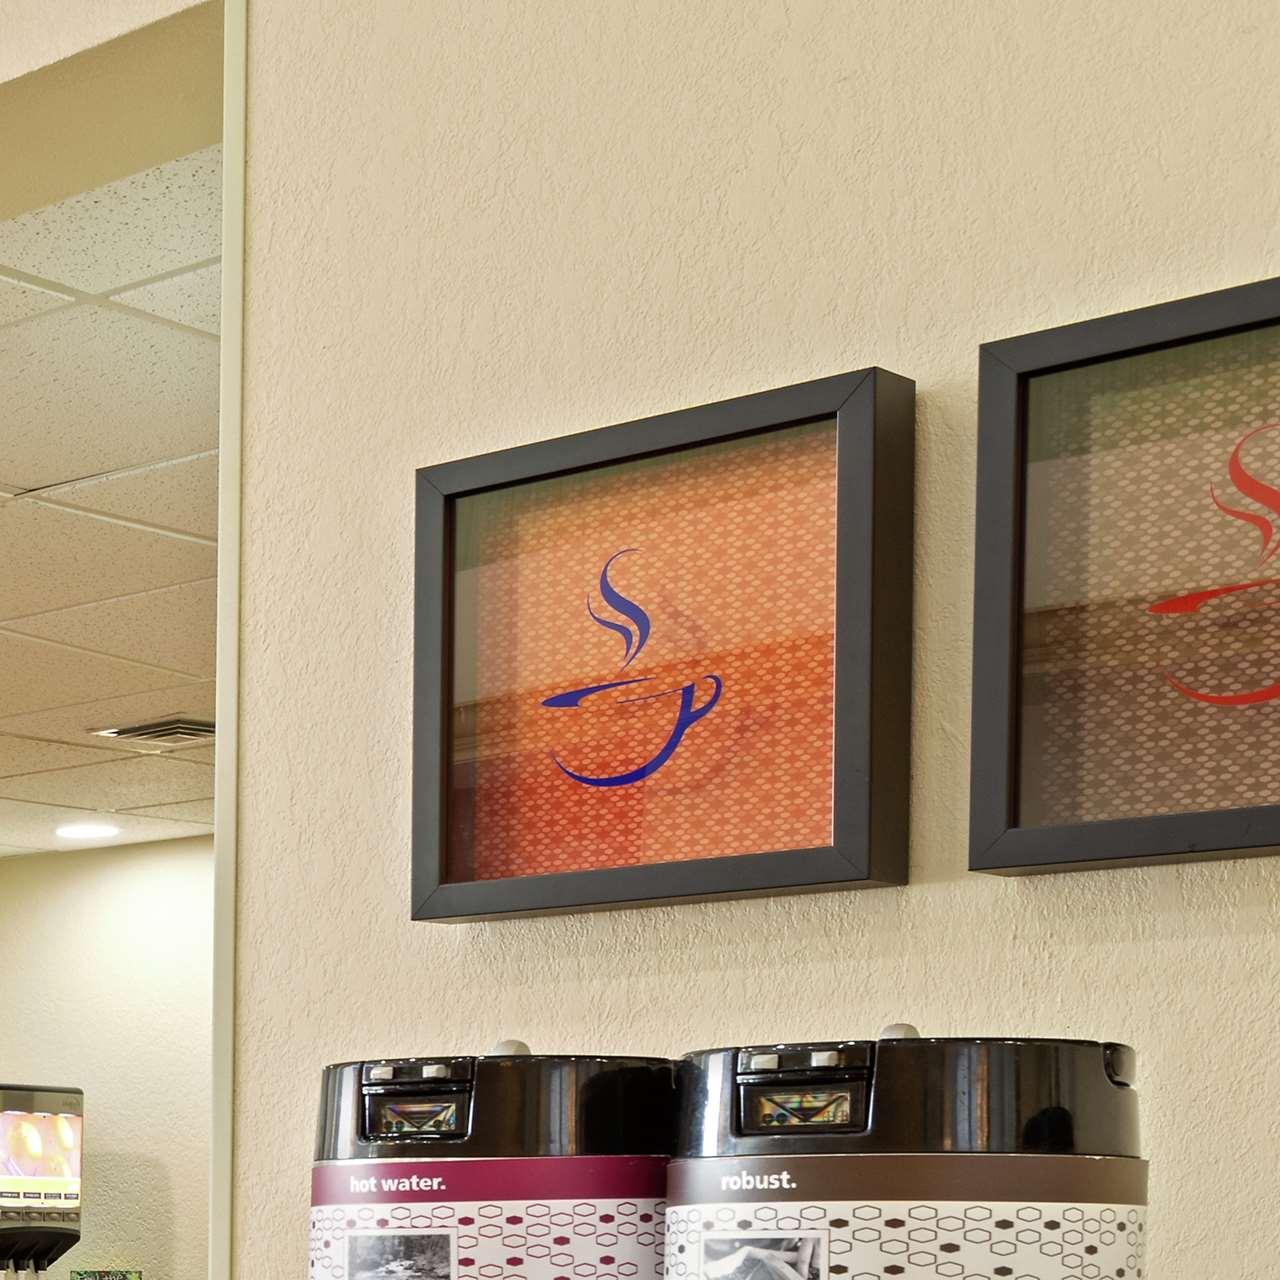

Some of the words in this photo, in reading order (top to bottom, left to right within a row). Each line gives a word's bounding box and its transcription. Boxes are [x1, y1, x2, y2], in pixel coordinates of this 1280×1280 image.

[350, 1175, 377, 1193] hot
[381, 1174, 447, 1191] water.
[720, 1170, 797, 1191] robust.
